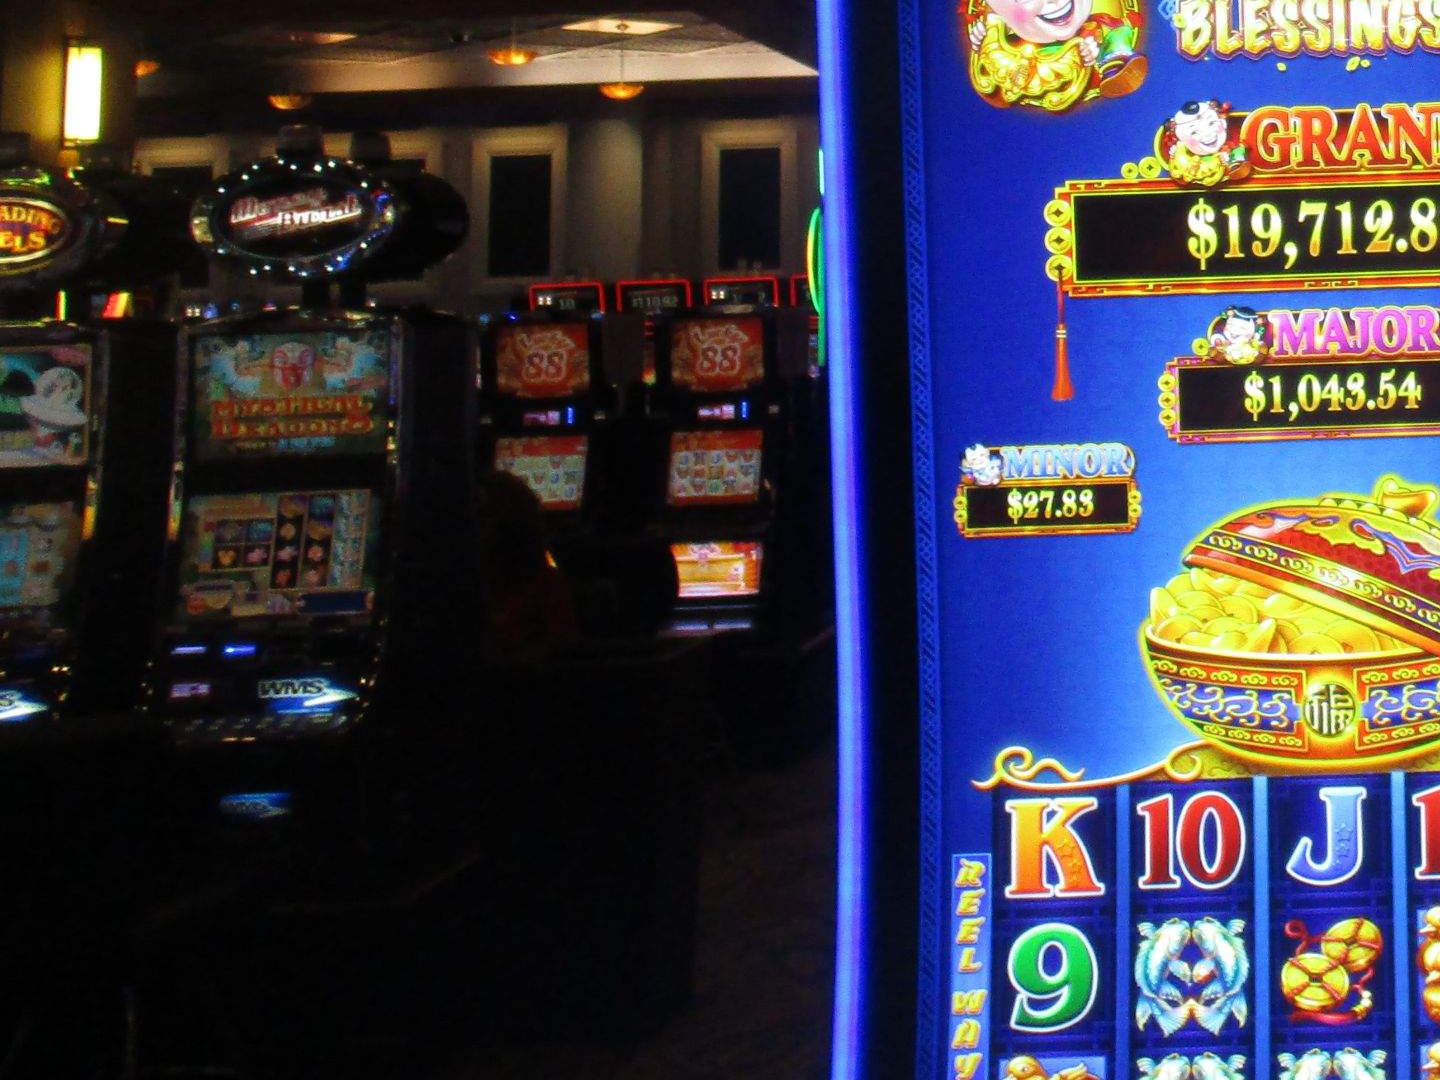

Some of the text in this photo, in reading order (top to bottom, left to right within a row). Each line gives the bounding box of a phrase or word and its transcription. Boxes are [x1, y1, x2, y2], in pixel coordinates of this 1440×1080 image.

[1244, 369, 1421, 420] $1,043.54
[1001, 443, 1130, 480] MINOR
[1007, 488, 1094, 524] $27.83
[1005, 797, 1105, 899] K
[1136, 791, 1246, 890] 10
[1286, 786, 1367, 887] J
[955, 858, 986, 972] REEL
[1008, 923, 1098, 1033] 9
